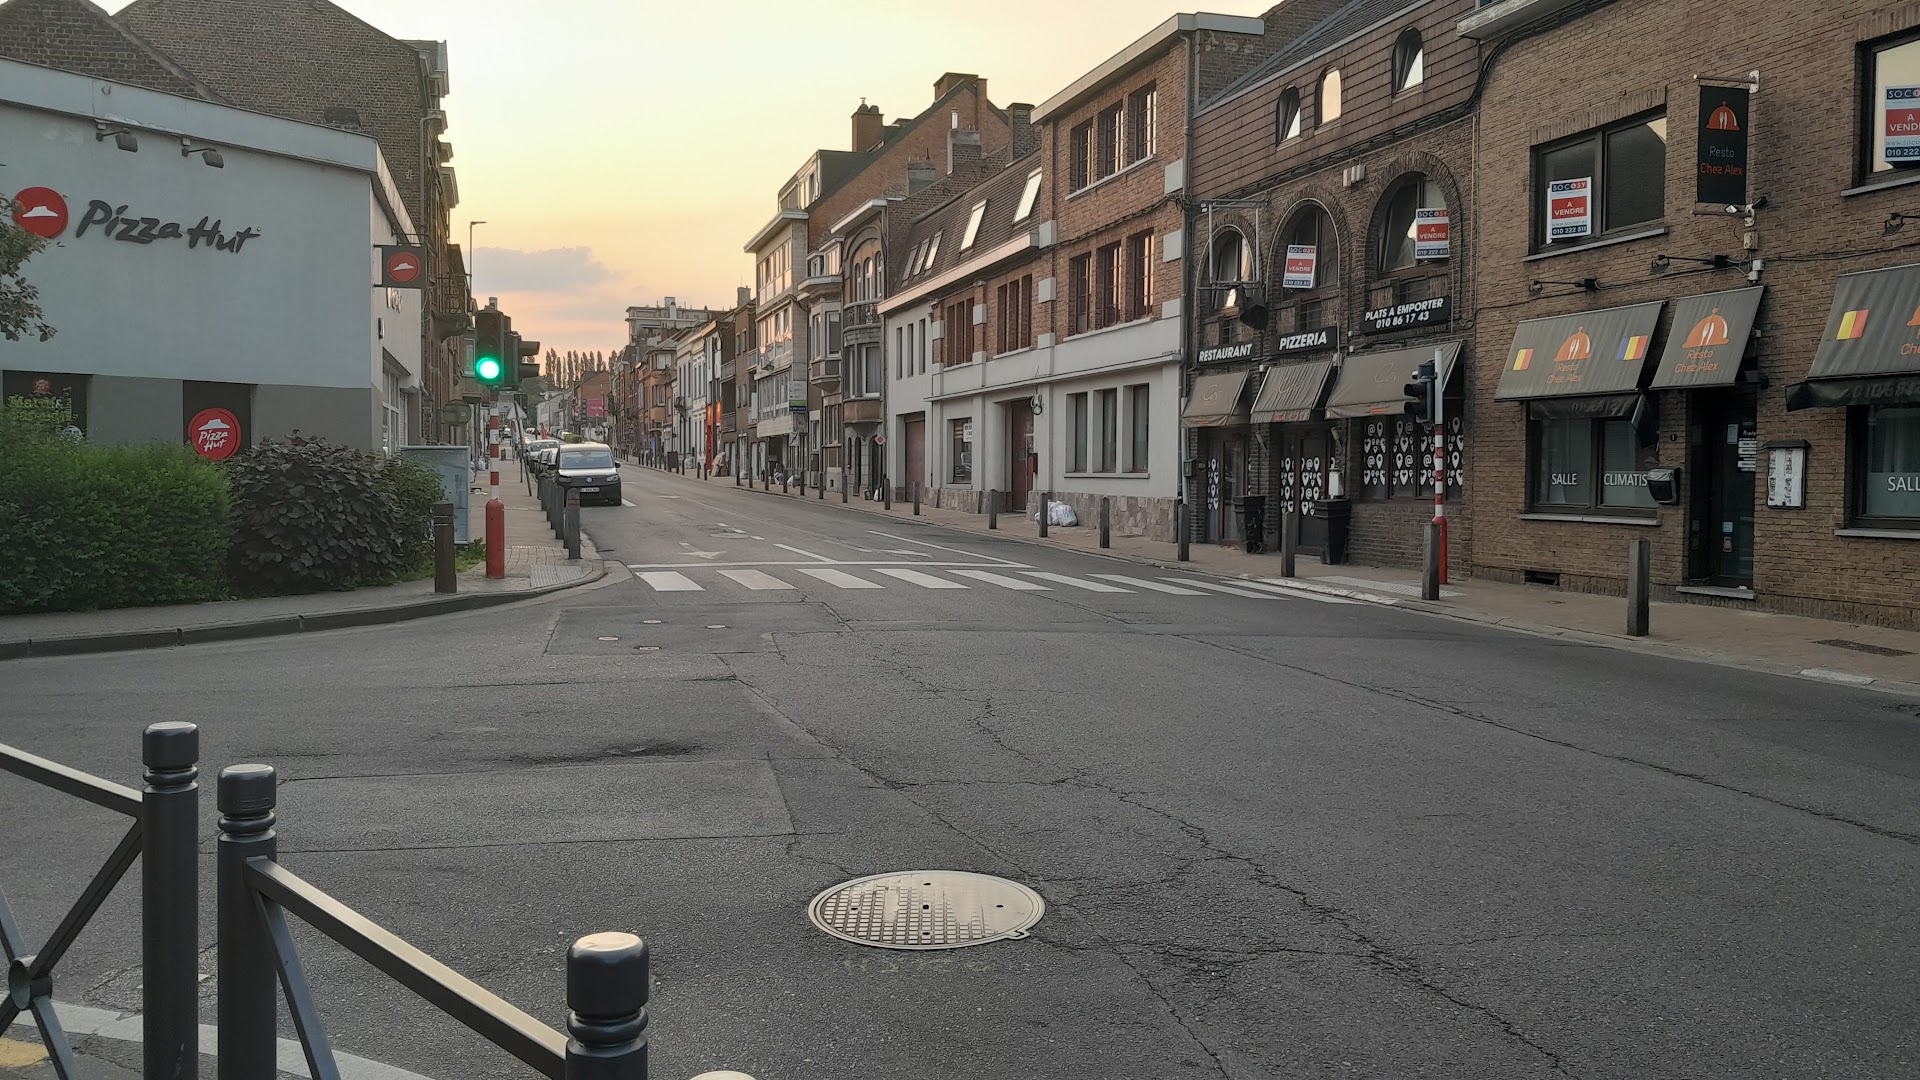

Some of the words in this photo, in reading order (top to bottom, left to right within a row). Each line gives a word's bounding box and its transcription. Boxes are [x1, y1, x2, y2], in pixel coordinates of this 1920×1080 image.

[1907, 113, 1914, 121] A
[1889, 122, 1920, 132] VEND
[1709, 145, 1735, 158] Resto
[1886, 149, 1901, 157] 010
[1903, 148, 1920, 156] 222
[1700, 162, 1723, 175] Chez
[1724, 164, 1744, 176] Alex
[1552, 182, 1587, 191] SOCOSY
[1418, 210, 1448, 218] SOCOSY
[1554, 206, 1585, 216] VENDRE
[75, 199, 183, 245] Pizza
[187, 215, 261, 254] Hut
[1419, 232, 1447, 240] VENDRE
[1364, 308, 1388, 322] PLATS
[1388, 306, 1396, 317] A
[1396, 298, 1444, 316] EMPORTER
[1375, 317, 1391, 329] 010
[1392, 315, 1403, 326] 86
[1405, 312, 1416, 324] 17
[1417, 311, 1430, 322] 43
[1278, 331, 1328, 351] PIZZERIA
[1198, 343, 1253, 362] RESTAURANT
[1686, 349, 1714, 359] Resto
[1558, 363, 1579, 372] Resto
[1674, 362, 1696, 373] Chez
[1698, 361, 1719, 371] Alex
[1546, 374, 1565, 384] Chez
[1566, 373, 1585, 383] Alex
[198, 429, 229, 444] Pizza
[203, 438, 228, 453] Hut
[1551, 473, 1578, 485] SALLE
[1603, 473, 1648, 487] CLIMATIS
